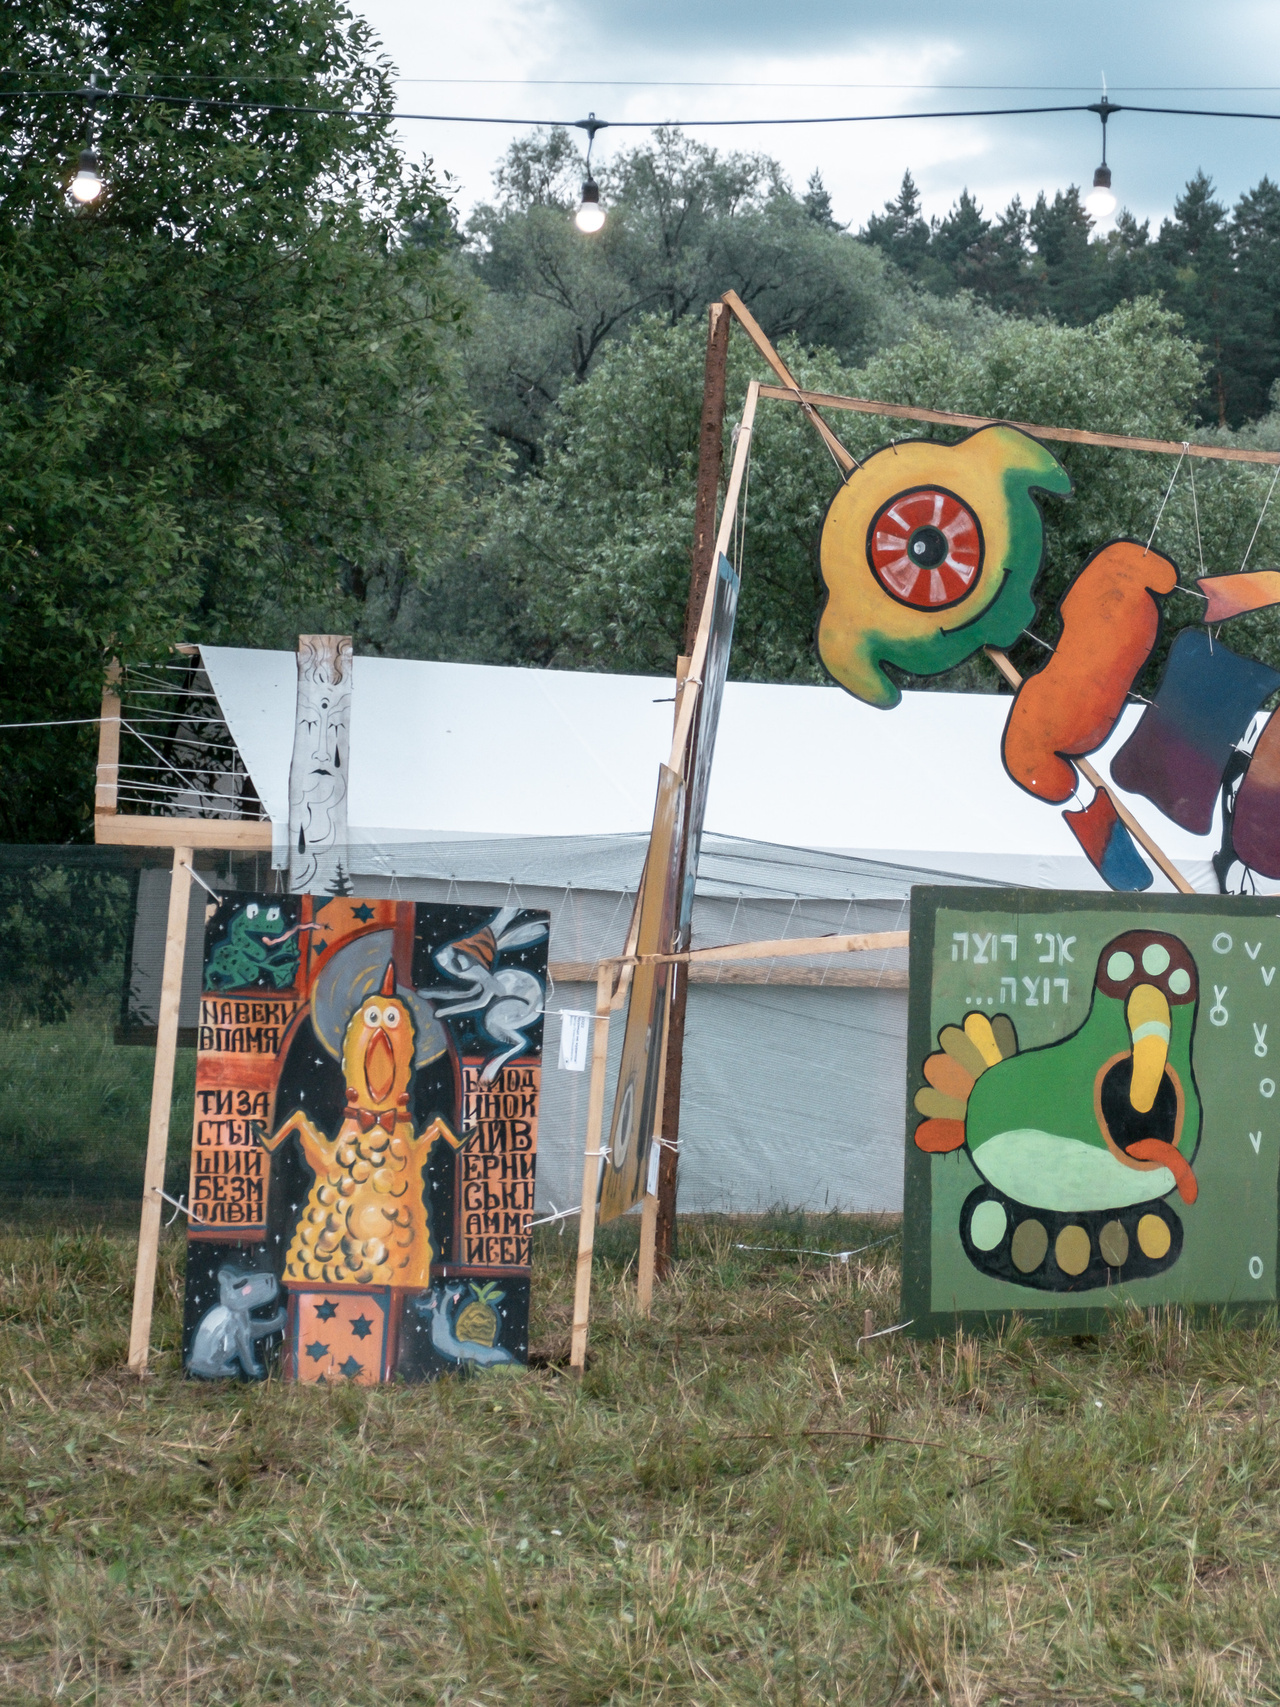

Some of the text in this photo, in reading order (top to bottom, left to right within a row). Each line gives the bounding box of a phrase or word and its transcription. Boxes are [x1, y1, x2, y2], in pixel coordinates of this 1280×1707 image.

[951, 932, 1077, 966] אני רוצה
[199, 1026, 281, 1054] ВПАМЯ
[197, 1090, 271, 1117] ТИЗА
[463, 1094, 538, 1120] ИНОК
[195, 1150, 264, 1176] ШИЙ
[463, 1153, 537, 1181] ЕРНИ
[192, 1175, 264, 1201] БЕЗМ
[464, 1181, 535, 1211] СЬКН
